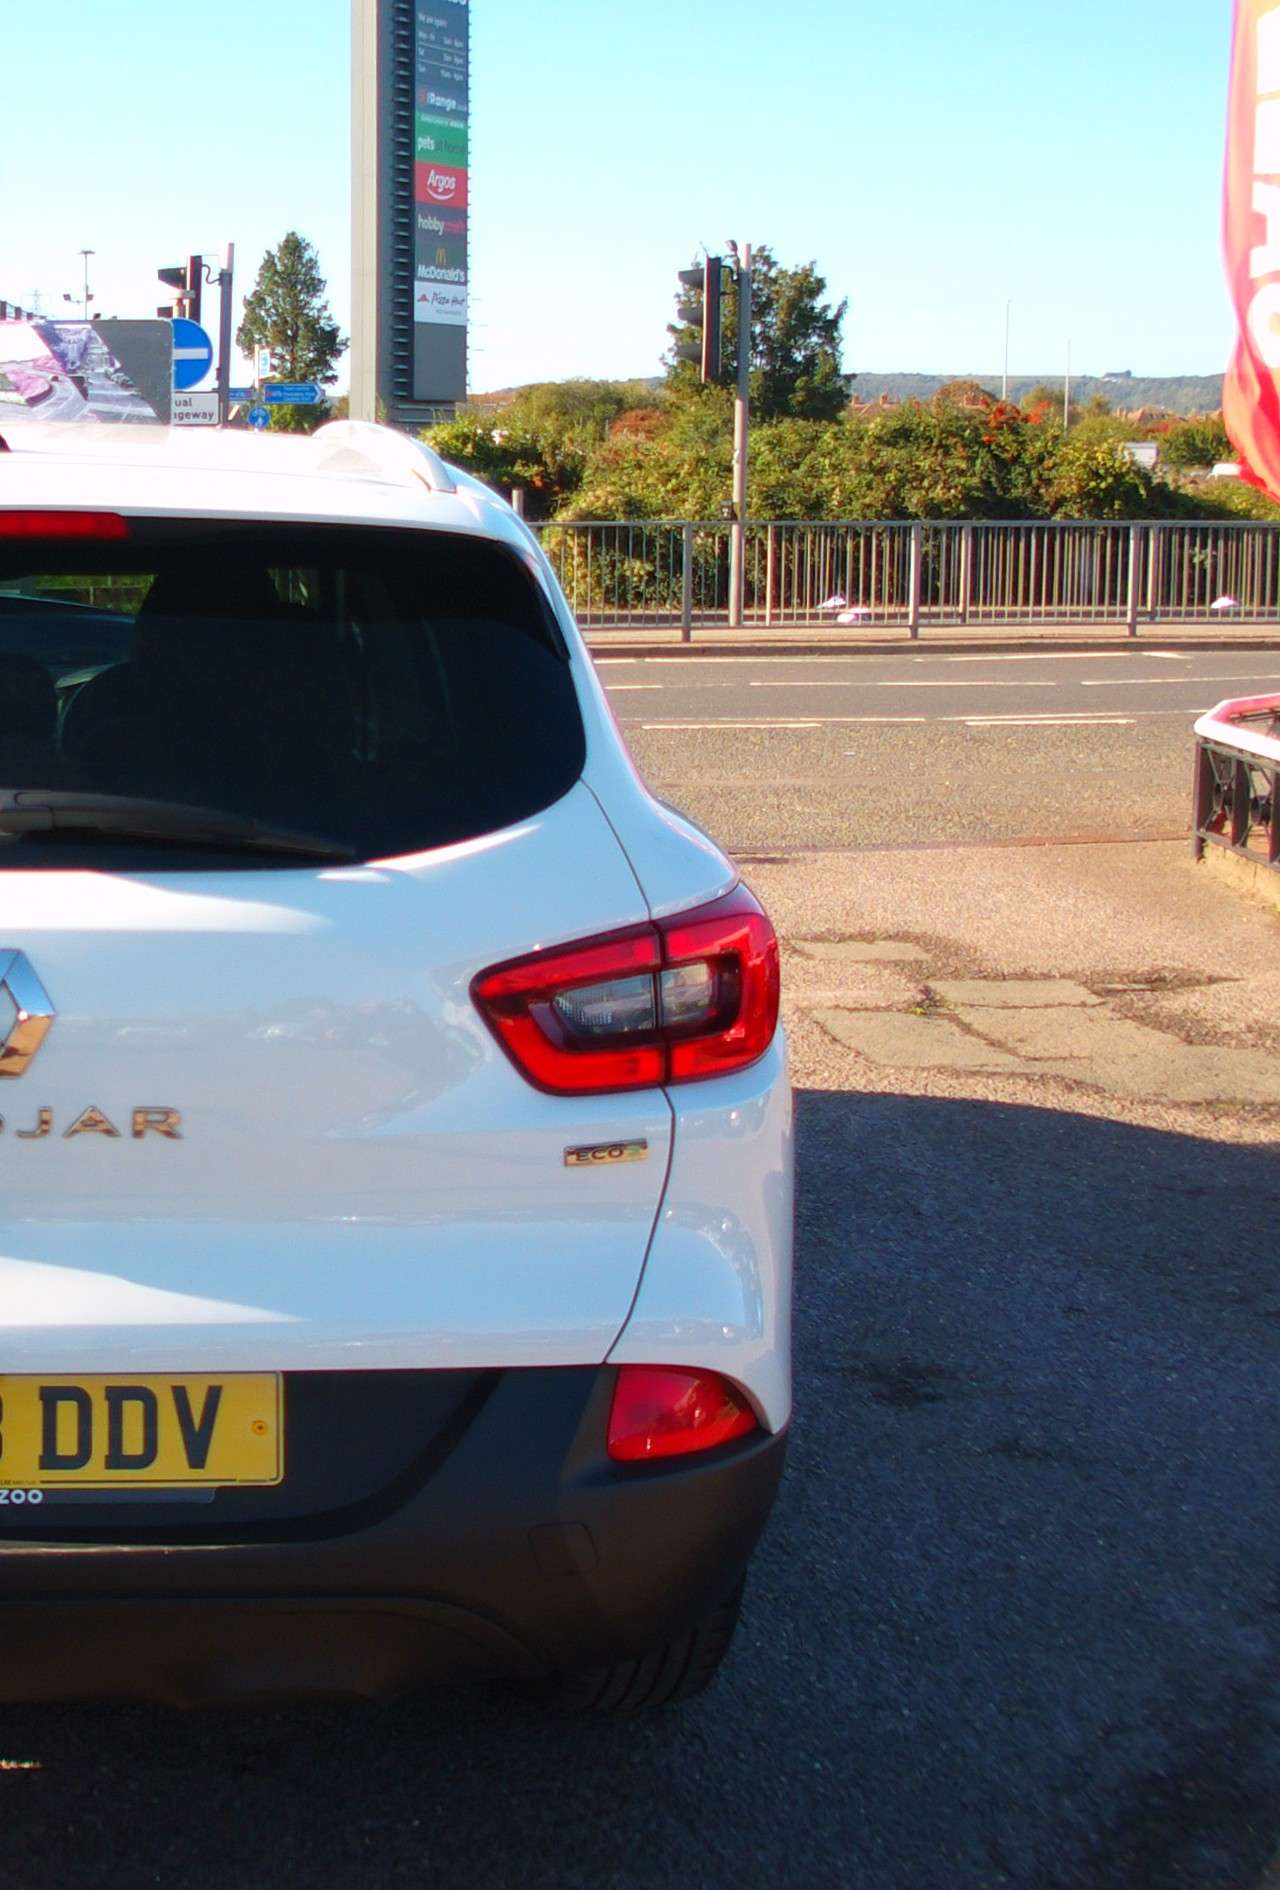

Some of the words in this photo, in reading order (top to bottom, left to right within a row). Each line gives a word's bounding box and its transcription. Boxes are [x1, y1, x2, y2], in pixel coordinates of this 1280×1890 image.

[427, 169, 457, 192] Argos
[417, 264, 465, 282] McDonald's
[174, 397, 192, 407] ual
[38, 1384, 224, 1471] DDV
